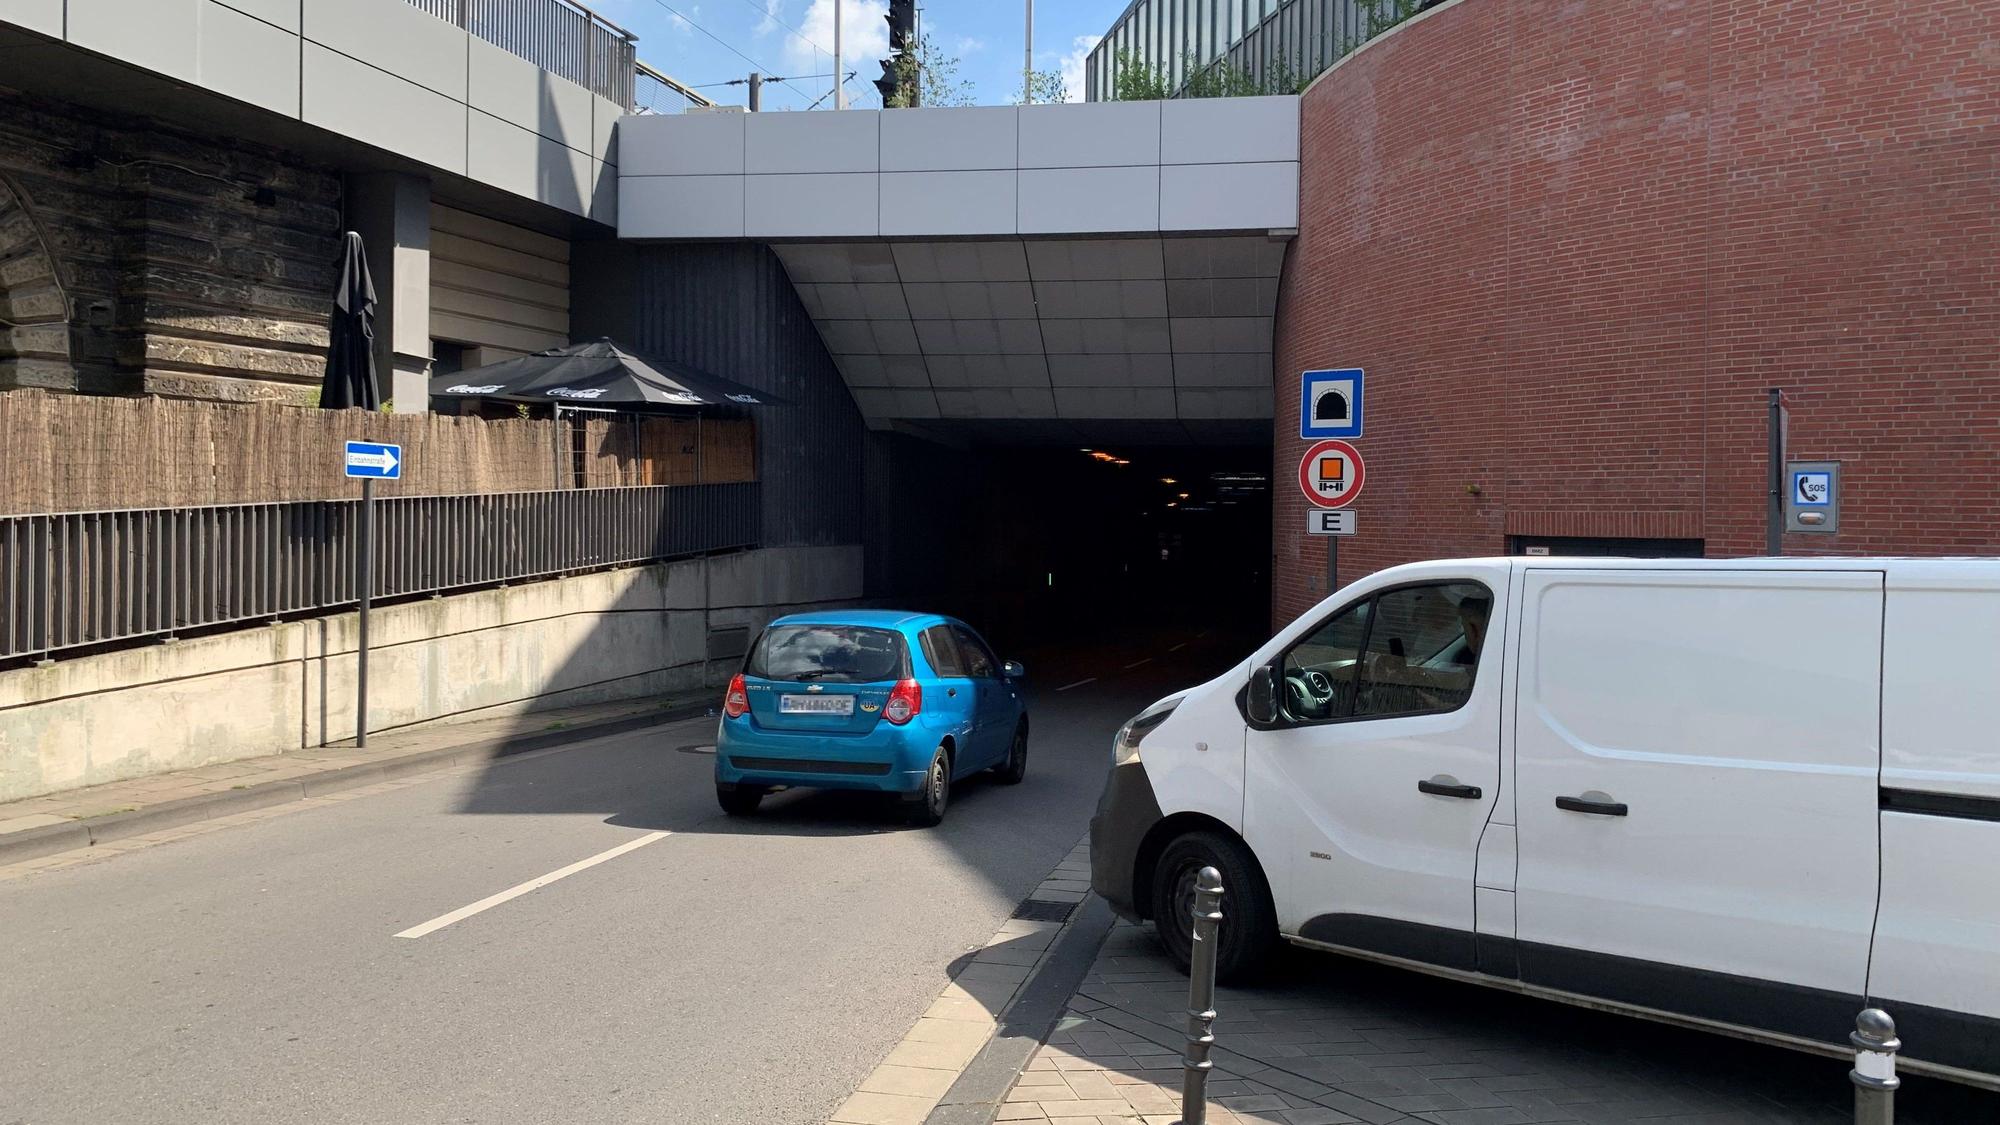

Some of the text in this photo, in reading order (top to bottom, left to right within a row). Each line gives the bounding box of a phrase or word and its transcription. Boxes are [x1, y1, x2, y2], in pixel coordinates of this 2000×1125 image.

[1808, 484, 1826, 492] SOS
[1322, 513, 1341, 531] E
[864, 700, 875, 709] UA
